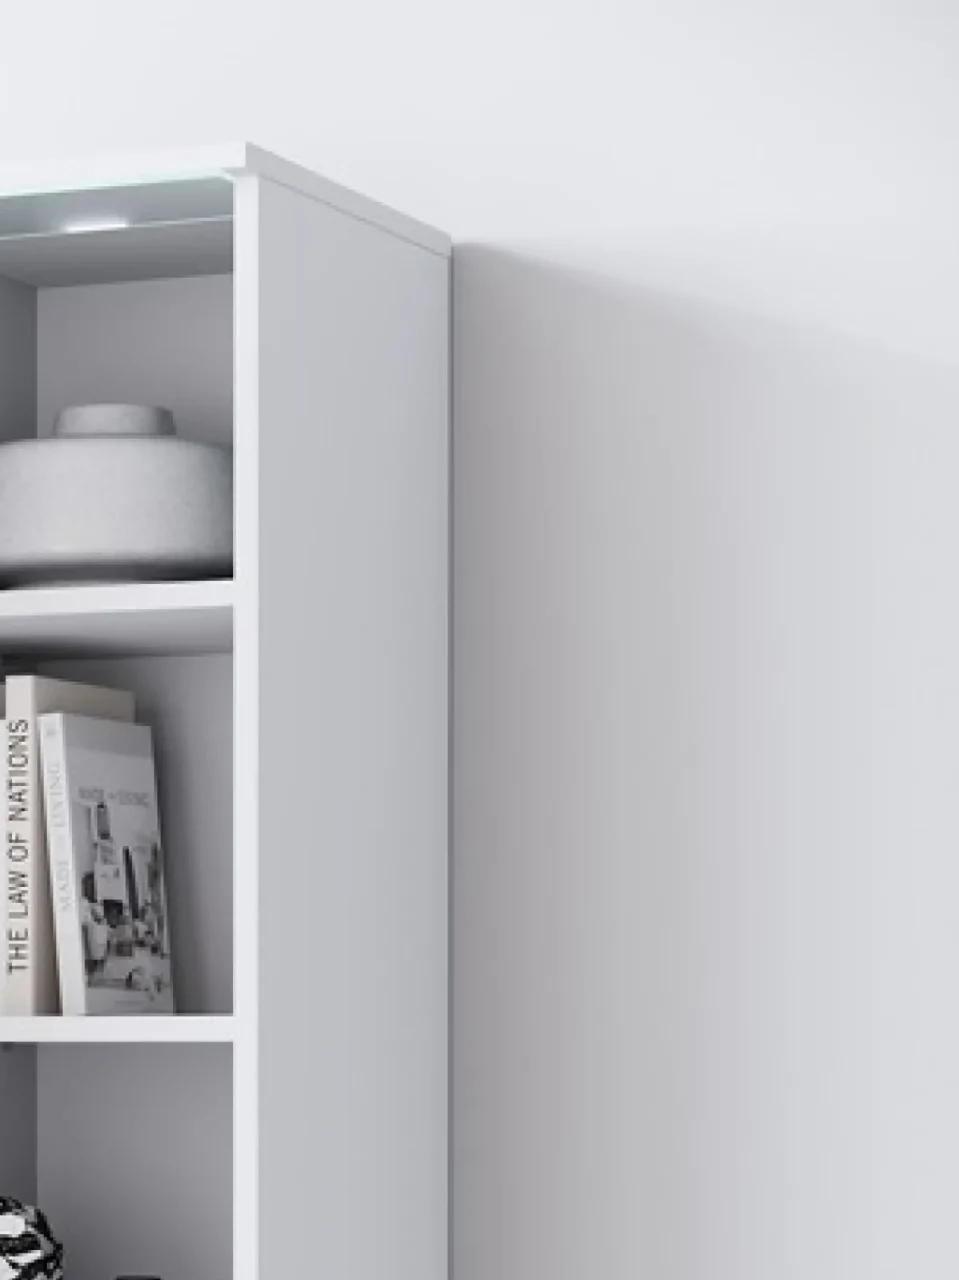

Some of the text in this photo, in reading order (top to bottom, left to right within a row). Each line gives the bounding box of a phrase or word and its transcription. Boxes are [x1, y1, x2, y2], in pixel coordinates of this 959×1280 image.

[6, 718, 29, 974] THE LAW OF NATIONS
